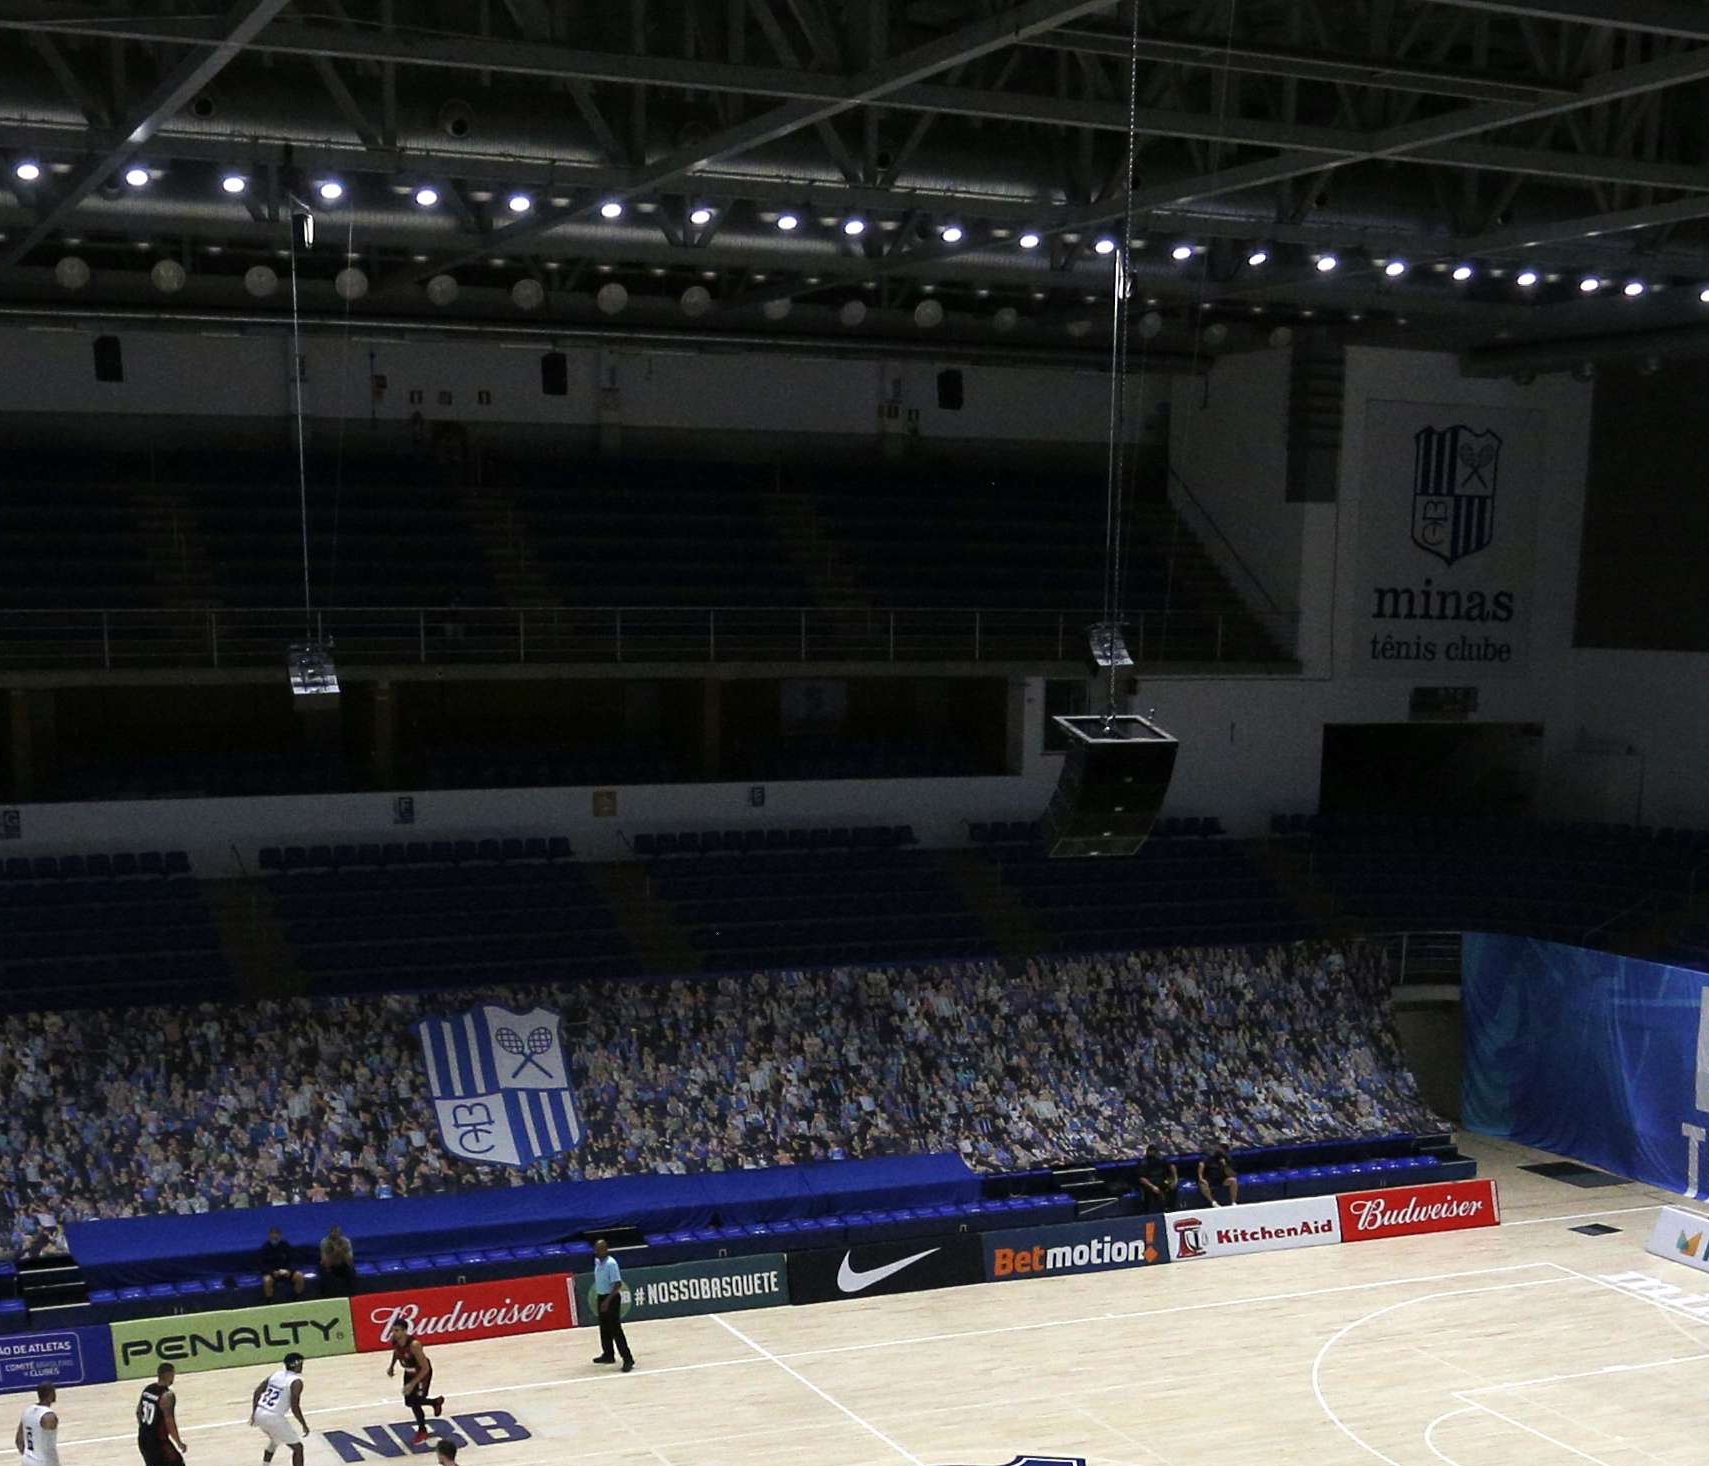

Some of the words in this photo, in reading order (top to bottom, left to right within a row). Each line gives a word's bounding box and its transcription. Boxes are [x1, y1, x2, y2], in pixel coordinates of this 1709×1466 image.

[1372, 579, 1514, 623] minas
[1370, 634, 1436, 662] tênis
[1446, 635, 1511, 662] clube
[1351, 1191, 1485, 1231] Budweiser
[1215, 1219, 1335, 1246] KitchenAid
[634, 1271, 779, 1306] #NOSSOBASQUETE
[371, 1297, 555, 1344] Budweiser
[14, 1344, 26, 1355] DE
[29, 1341, 72, 1353] ATLETAS
[121, 1317, 340, 1366] PENALTY
[142, 1400, 156, 1427] 30
[323, 1410, 533, 1463] NBB
